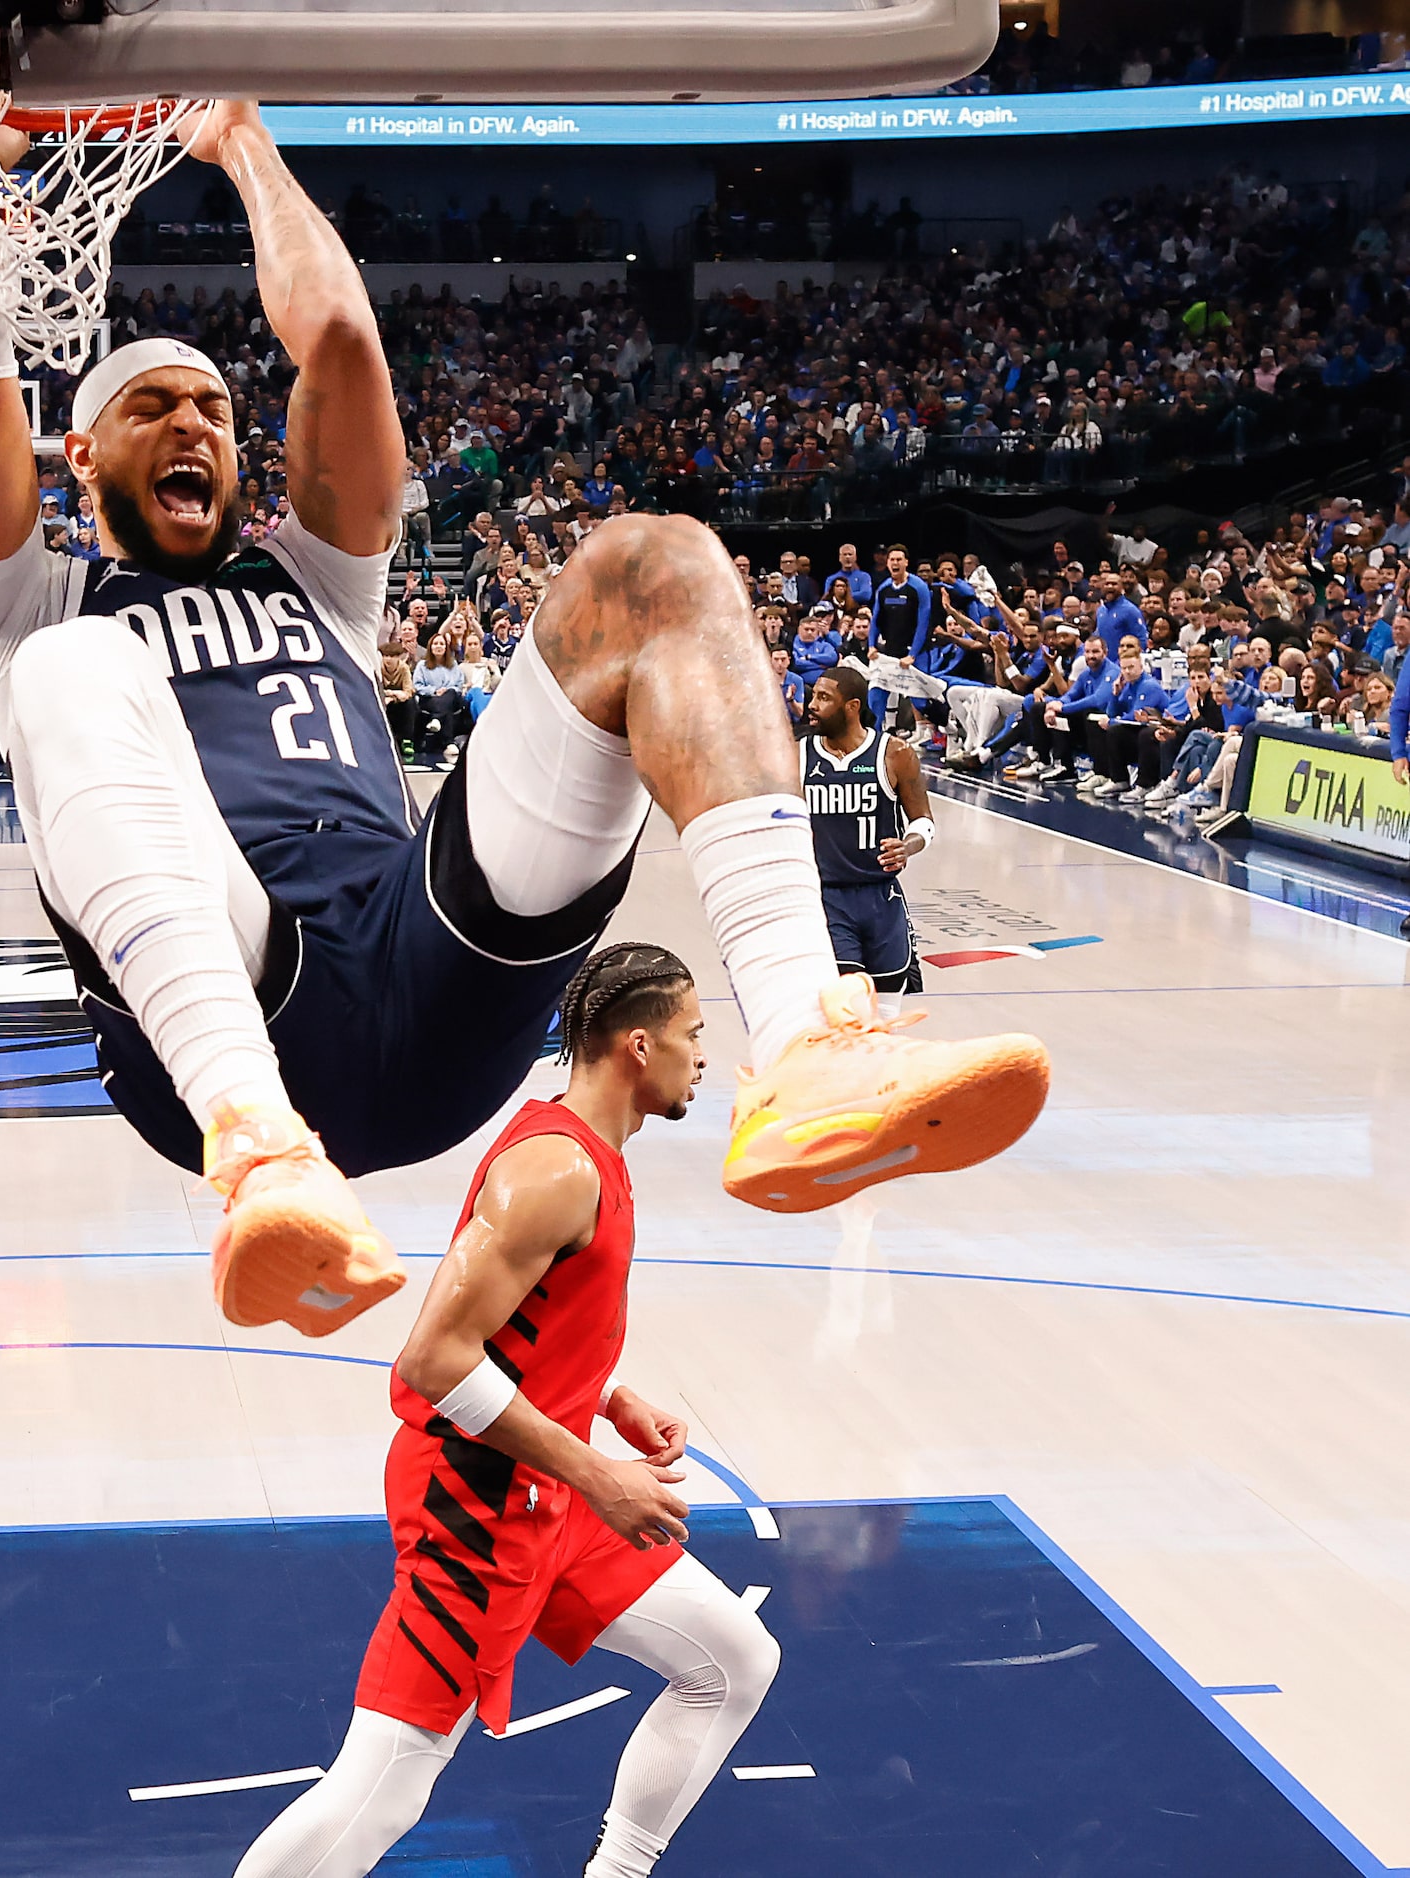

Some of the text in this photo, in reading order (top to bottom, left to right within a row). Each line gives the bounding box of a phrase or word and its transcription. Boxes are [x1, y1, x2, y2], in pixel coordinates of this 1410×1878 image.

[1199, 95, 1220, 113] #1
[1225, 89, 1304, 113] Hospital
[1309, 90, 1326, 107] in
[1332, 85, 1384, 106] DFW.
[346, 115, 580, 137] #1 Hospital in DFW. Again.
[777, 106, 1018, 132] #1 Hospital in DFW. Again.
[256, 672, 359, 768] 21
[852, 765, 875, 773] chime
[804, 783, 878, 815] MAVS
[1313, 768, 1365, 832] TIAA
[857, 816, 876, 850] 11
[921, 888, 1058, 932] American
